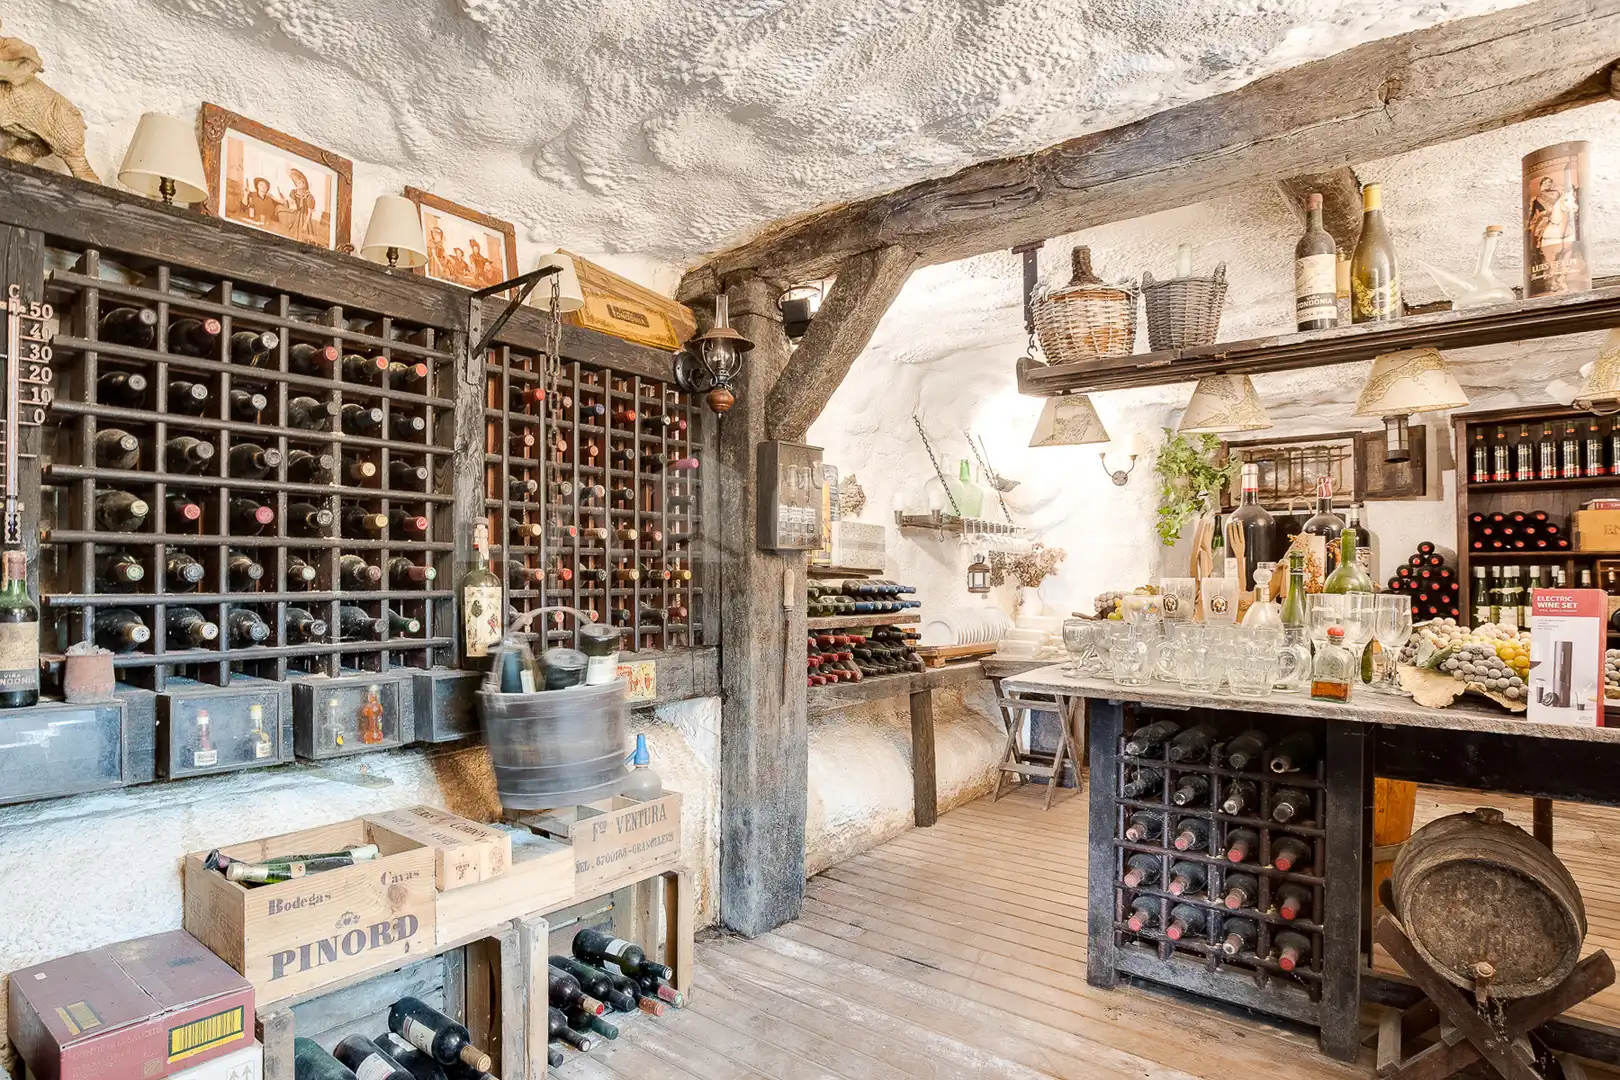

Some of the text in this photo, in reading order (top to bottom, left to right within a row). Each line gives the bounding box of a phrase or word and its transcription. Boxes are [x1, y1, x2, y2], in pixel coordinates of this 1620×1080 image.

[8, 284, 20, 299] C
[29, 302, 53, 319] 50
[29, 324, 53, 341] 40
[29, 344, 53, 362] 30
[29, 366, 53, 383] 20
[31, 387, 52, 403] 10
[33, 409, 46, 424] 0
[615, 803, 667, 834] VENTURA
[380, 870, 420, 886] Cavas
[268, 893, 332, 916] Bodegas
[267, 914, 419, 982] PINORD
